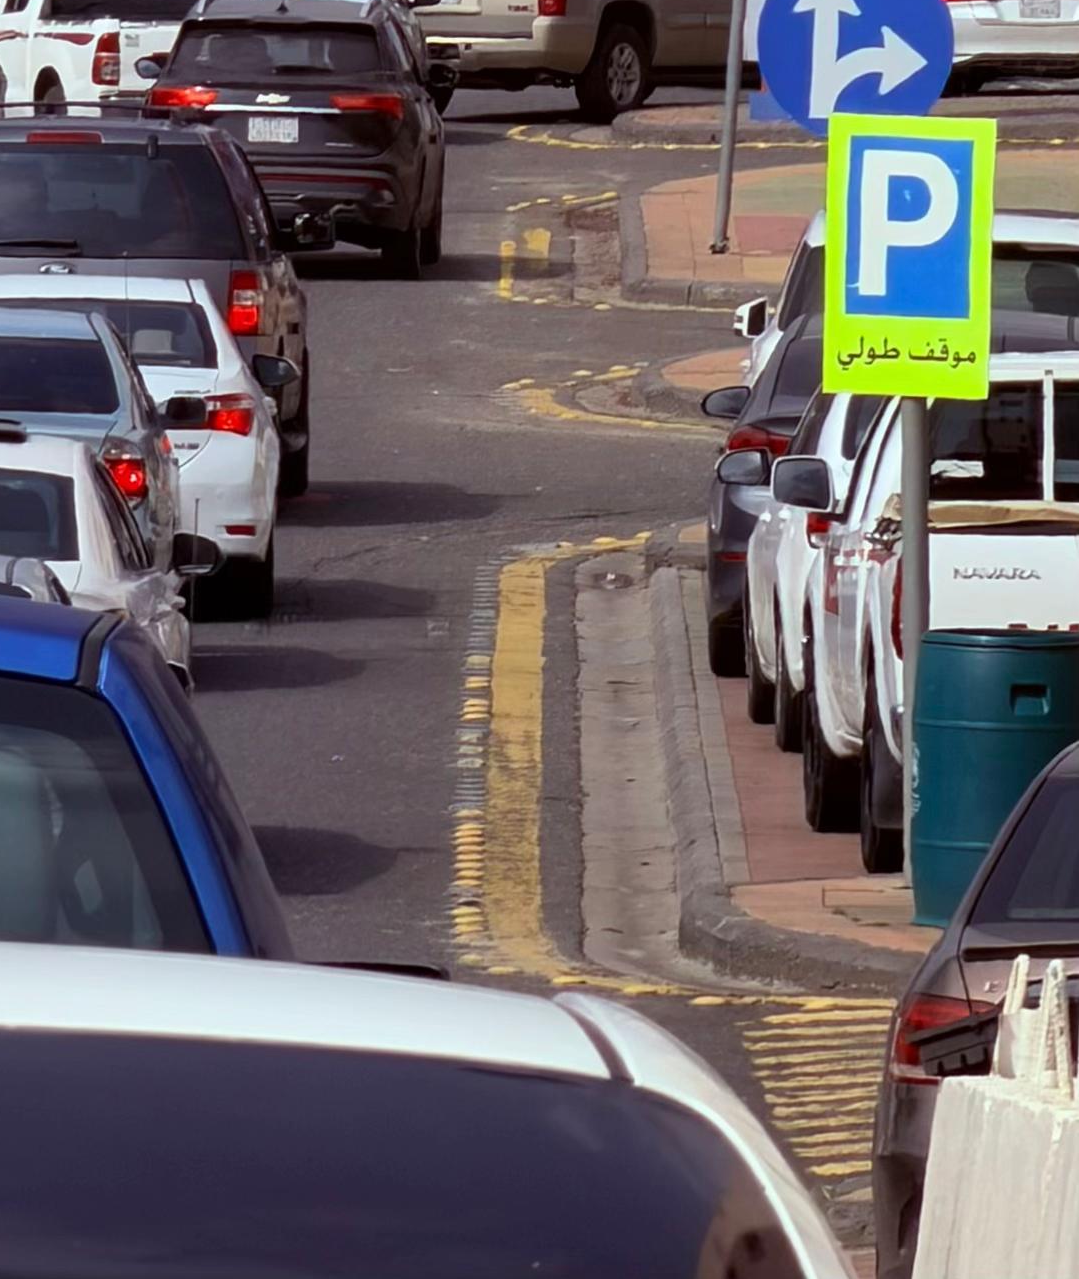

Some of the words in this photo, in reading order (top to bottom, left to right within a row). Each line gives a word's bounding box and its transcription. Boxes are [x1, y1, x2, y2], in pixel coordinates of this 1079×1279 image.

[858, 149, 959, 296] P
[837, 335, 901, 371] طولي
[908, 337, 977, 369] موقف
[952, 566, 1042, 580] NAVARA
